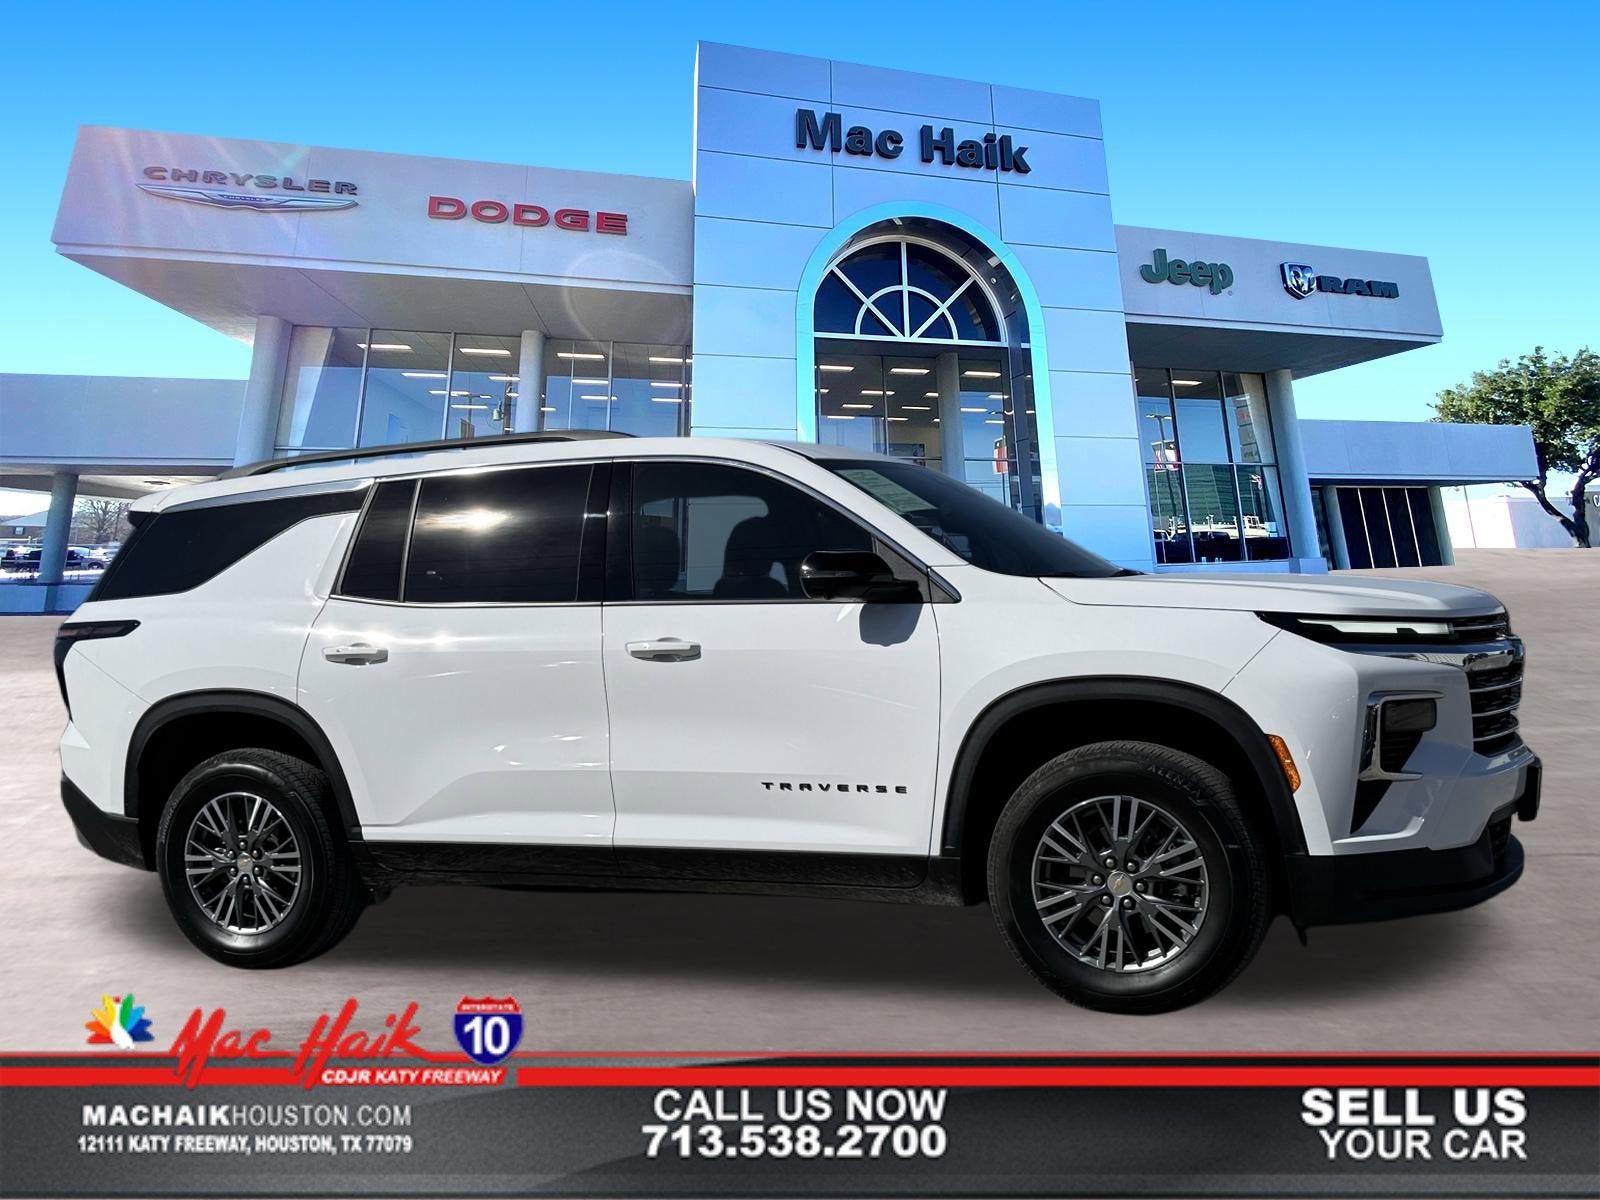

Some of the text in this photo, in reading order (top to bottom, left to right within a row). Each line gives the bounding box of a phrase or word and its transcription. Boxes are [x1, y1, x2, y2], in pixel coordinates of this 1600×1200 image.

[795, 108, 1032, 174] Mac Haik
[143, 165, 359, 196] CHRYSLER
[427, 196, 629, 236] DODGE
[1140, 248, 1234, 296] Jeep
[1316, 275, 1400, 299] RAM
[761, 781, 908, 795] TRAVERSE
